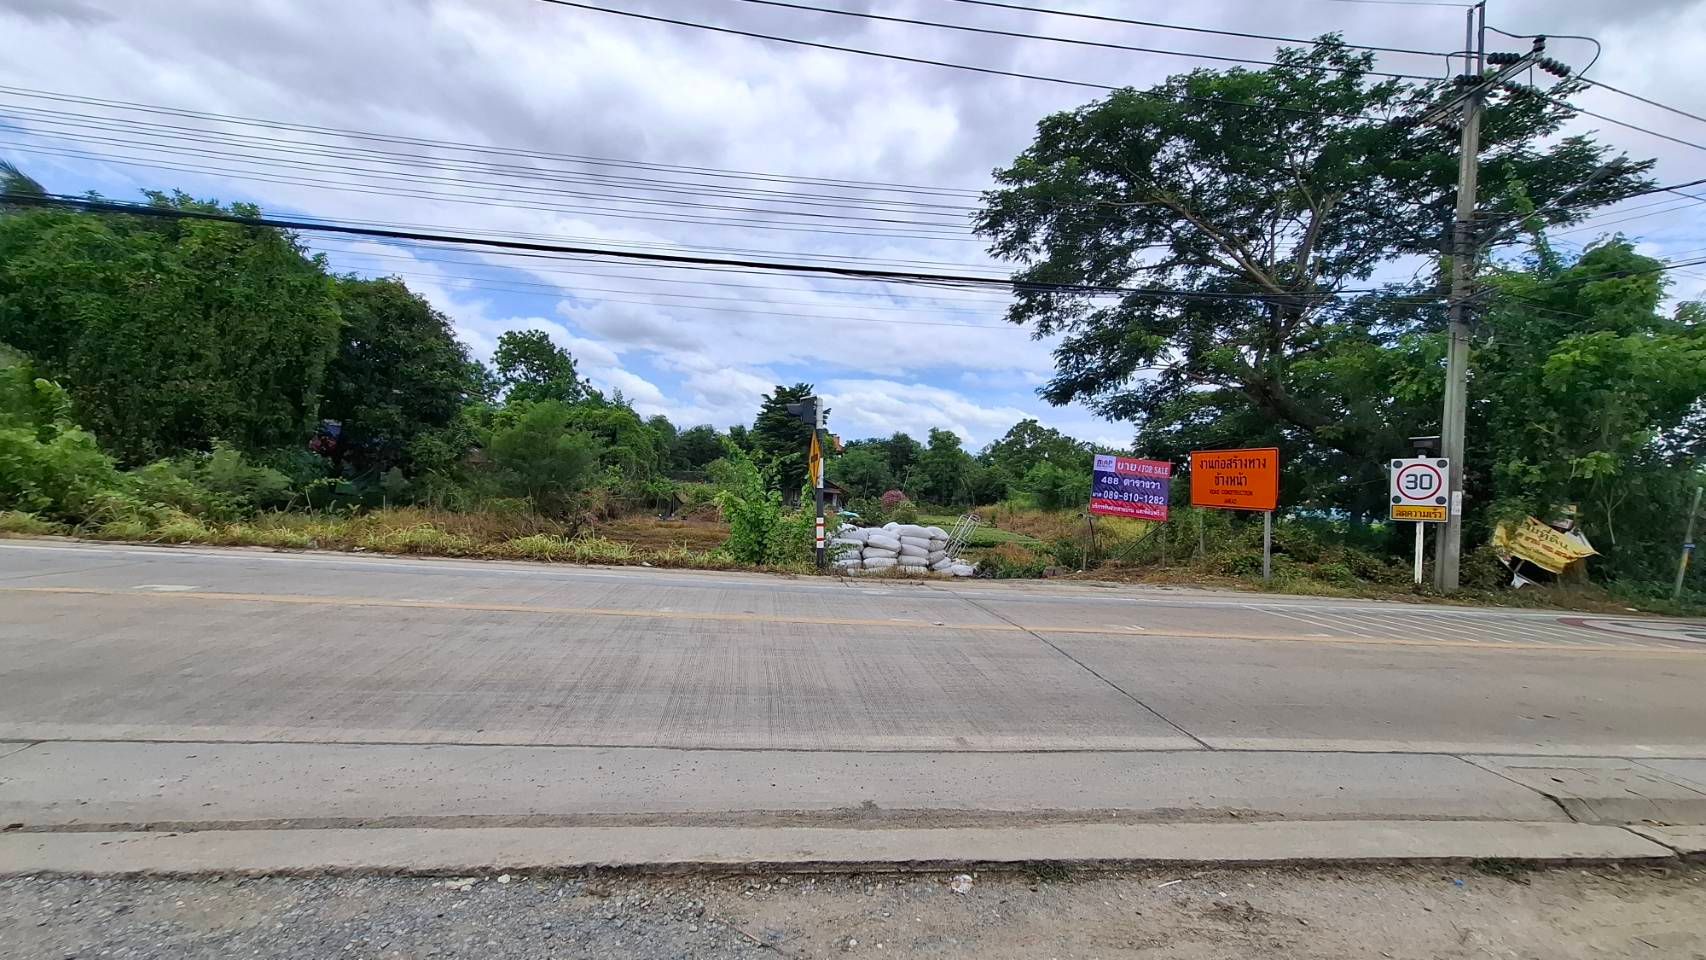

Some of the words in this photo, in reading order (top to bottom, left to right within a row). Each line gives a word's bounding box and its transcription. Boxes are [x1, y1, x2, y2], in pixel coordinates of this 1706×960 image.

[1154, 464, 1169, 475] SALE
[1200, 456, 1267, 470] งานก่อสร้างทาง
[1101, 476, 1119, 485] 488
[1123, 478, 1161, 490] ตารางวา
[1214, 472, 1248, 486] ข้างหน้า
[1405, 473, 1433, 490] 30
[1103, 490, 1165, 504] 089-810-1282
[1396, 508, 1442, 518] ลดความเร็ว
